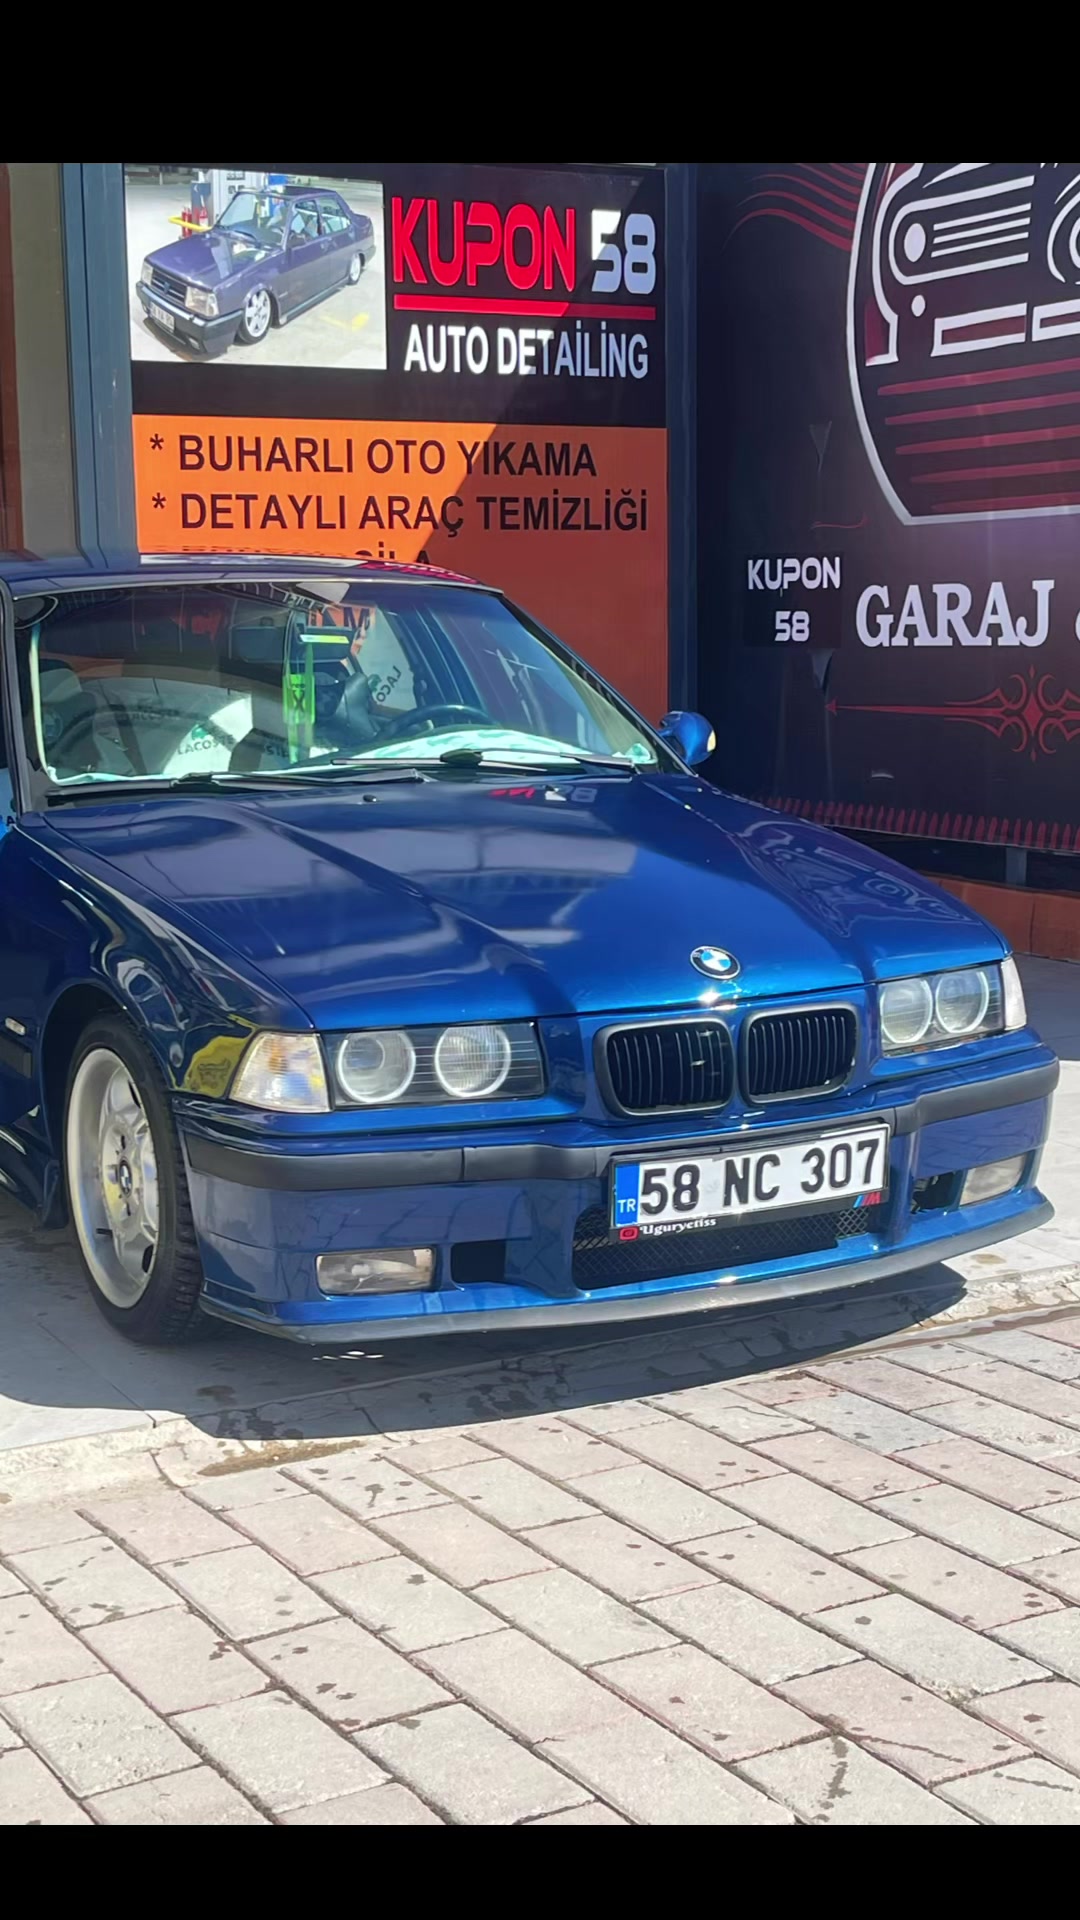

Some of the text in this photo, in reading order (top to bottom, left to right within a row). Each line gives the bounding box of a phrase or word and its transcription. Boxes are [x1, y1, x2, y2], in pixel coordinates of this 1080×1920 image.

[391, 196, 656, 297] KUPON 58
[403, 320, 648, 379] AUTO DETAİLİNG
[179, 434, 597, 477] BUHARLI OTO YIKAMA
[181, 488, 648, 538] DETAYLI ARAÇ TEMİZLİĞİ
[748, 556, 841, 590] KUPON
[774, 610, 810, 642] 58
[856, 579, 1055, 648] GARAJ
[640, 1137, 881, 1216] 58 NC 307
[617, 1198, 637, 1214] TR
